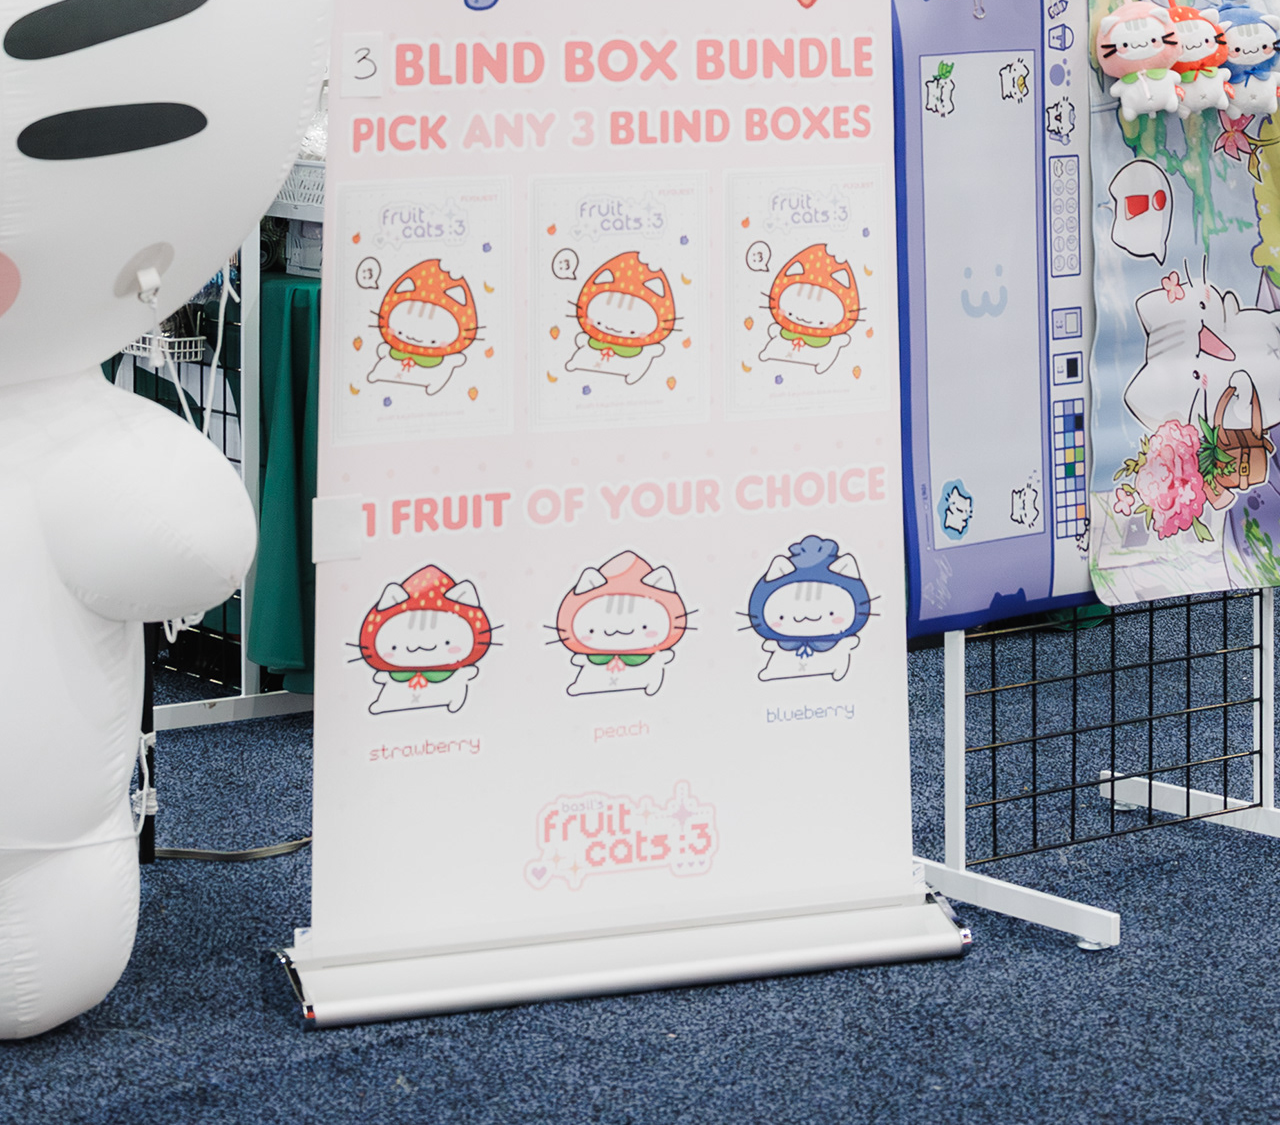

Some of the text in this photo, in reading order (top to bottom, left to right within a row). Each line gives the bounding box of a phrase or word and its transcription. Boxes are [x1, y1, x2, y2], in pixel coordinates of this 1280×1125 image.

[354, 47, 377, 80] 3
[395, 36, 874, 86] BLIND BOX BUNDLE
[353, 104, 872, 153] PICK ANY 3 BLIND BOXES
[579, 201, 623, 218] fruit
[771, 194, 812, 211] fruit
[382, 207, 425, 226] fruit
[600, 214, 643, 231] cats
[790, 208, 830, 224] cats
[402, 221, 444, 239] cats
[361, 502, 376, 537] 1
[392, 492, 511, 535] FRUIT
[527, 487, 584, 525] OF
[600, 480, 720, 520] YOUR
[735, 466, 886, 511] CHOICE
[766, 702, 855, 724] blueberry
[594, 720, 650, 744] peach
[369, 737, 481, 761] strawberry
[561, 799, 604, 813] basil's
[544, 804, 631, 843] fruit
[585, 823, 712, 867] cats :3
